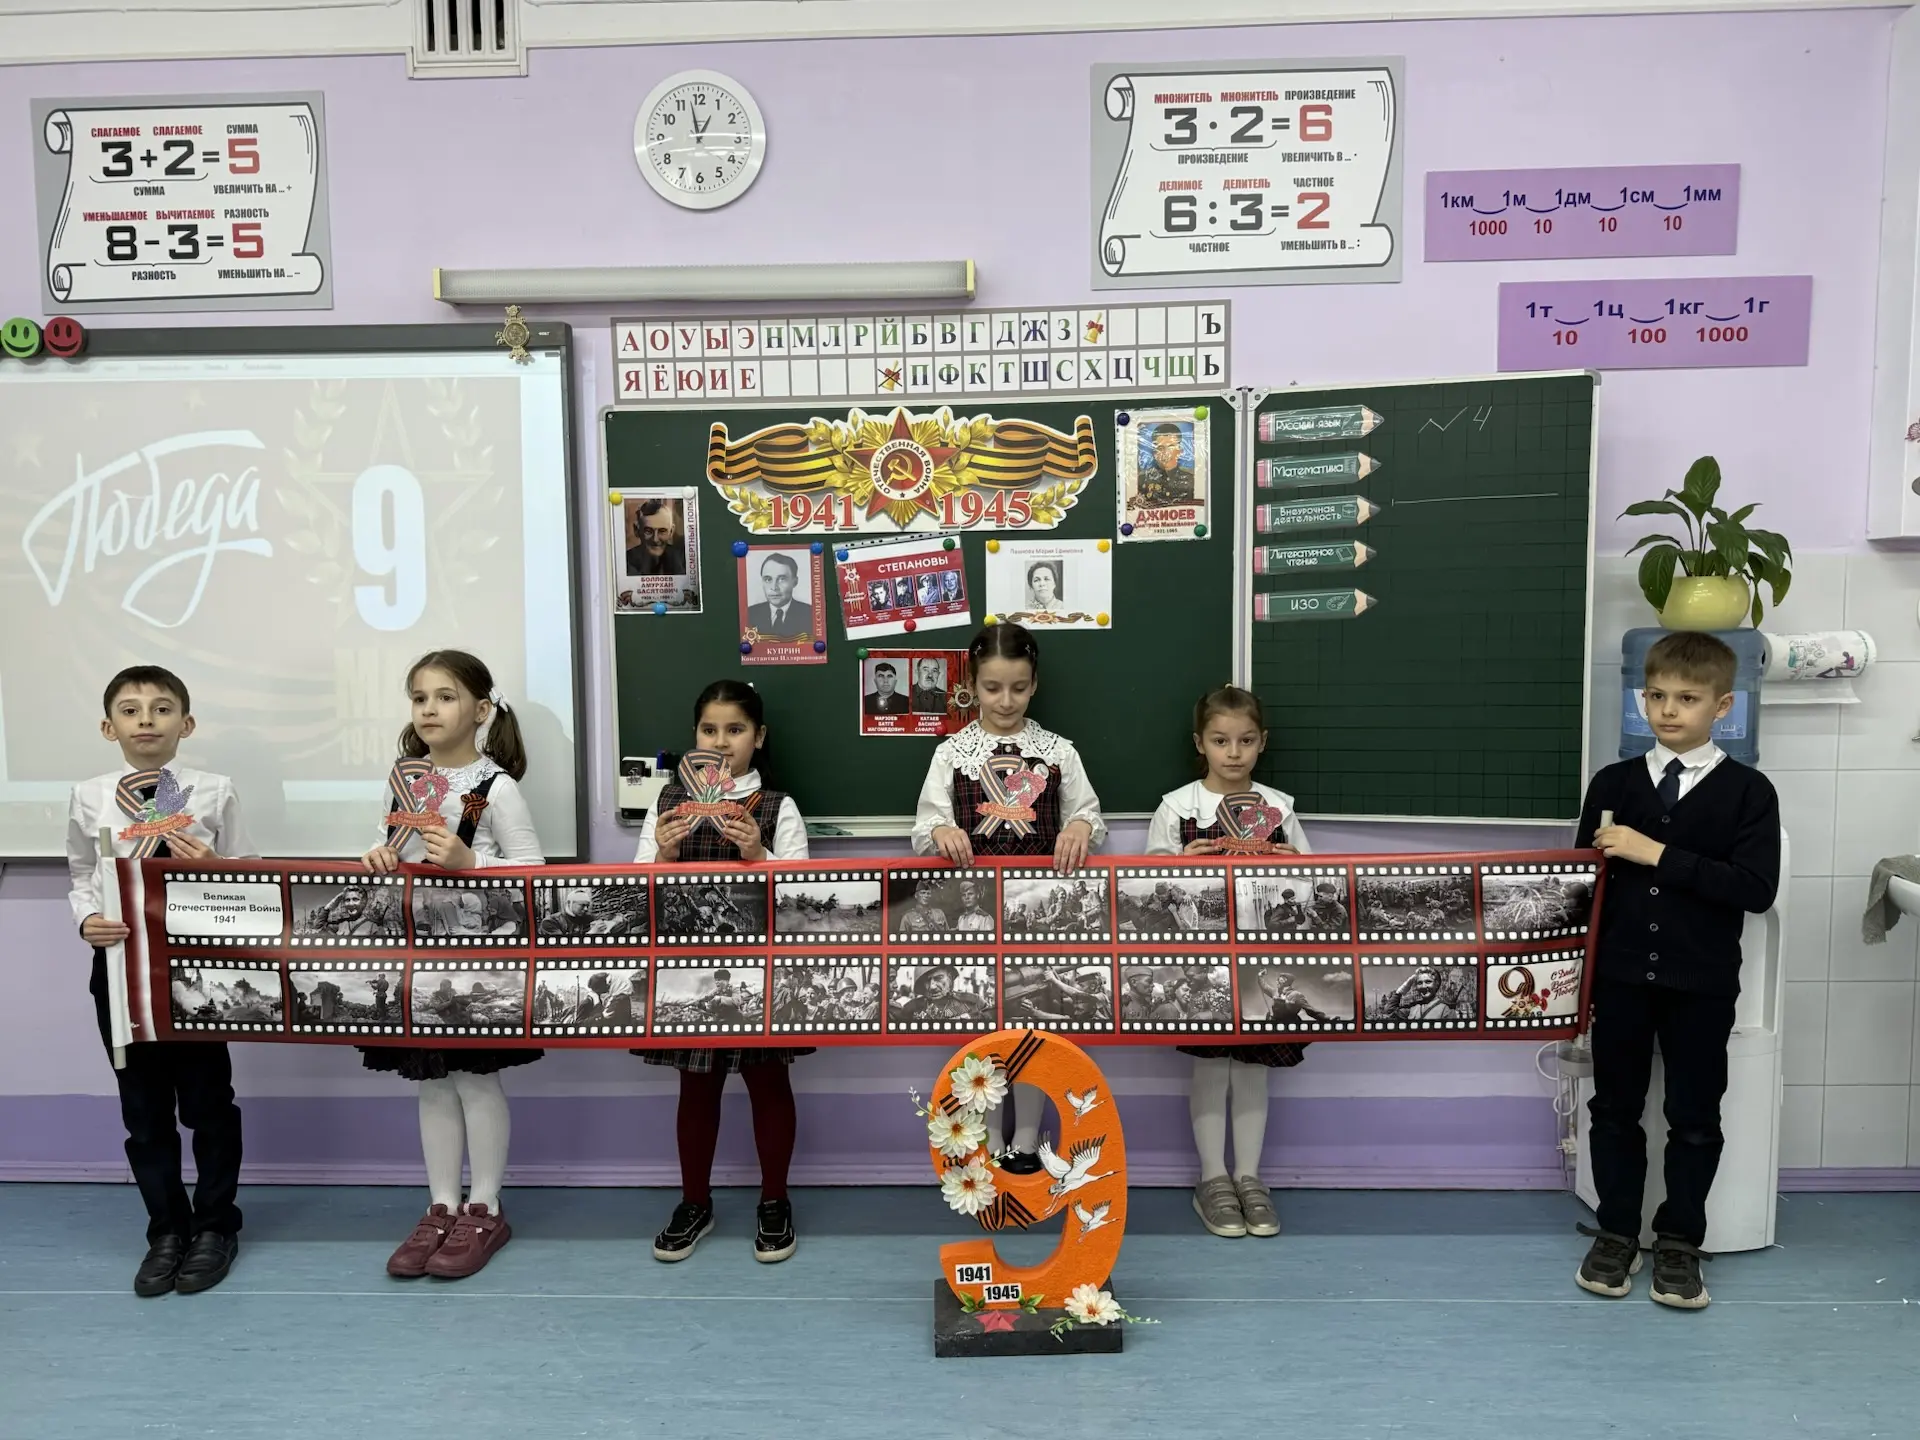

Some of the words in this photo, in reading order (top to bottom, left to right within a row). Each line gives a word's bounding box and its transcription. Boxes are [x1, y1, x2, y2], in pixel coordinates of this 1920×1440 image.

[693, 94, 706, 105] 12
[1154, 93, 1212, 104] МНОЖИТЕЛЬ
[1220, 91, 1278, 102] МНОЖИТЕЛЬ
[1285, 89, 1356, 100] ПРОИЗВЕДЕНИЕ
[676, 100, 685, 111] 11
[715, 99, 720, 110] 1
[663, 114, 675, 124] 10
[728, 113, 736, 124] 2
[91, 127, 140, 138] СЛАГАЕМОЕ
[153, 125, 203, 136] СЛАГАЕМОЕ
[226, 124, 258, 134] СУММА
[657, 134, 664, 144] 9
[664, 154, 671, 164] 8
[728, 155, 735, 164] 4
[1178, 153, 1248, 164] ПРОИЗВЕДЕНИЕ
[1282, 152, 1334, 162] УВЕЛИЧИТЬ
[1337, 152, 1342, 162] В
[678, 168, 686, 178] 7
[696, 172, 704, 183] 6
[716, 167, 722, 178] 5
[214, 184, 263, 194] УВЕЛИЧИТЬ
[265, 184, 276, 193] НА
[1159, 180, 1202, 192] ДЕЛИМОЕ
[1223, 178, 1270, 190] ДЕЛИТЕЛЬ
[1294, 178, 1334, 188] ЧАСТНОЕ
[134, 186, 165, 196] СУММА
[83, 210, 148, 222] УМЕНЬШАЕМОЕ
[156, 209, 214, 220] ВЫЧИТАЕМОЕ
[224, 208, 269, 218] РАЗНОСТЬ
[1469, 220, 1507, 236] 1000
[1534, 219, 1552, 234] 10
[1598, 217, 1617, 232] 10
[1663, 216, 1682, 231] 10
[1189, 242, 1230, 252] ЧАСТНОЕ
[1281, 240, 1338, 250] УМЕНЬШИТЬ
[1340, 240, 1346, 249] В
[132, 270, 176, 281] РАЗНОСТЬ
[218, 268, 272, 279] УМЕНЬШИТЬ
[274, 268, 285, 278] НА
[622, 330, 640, 350] А
[650, 330, 669, 350] О
[680, 329, 697, 350] У
[706, 328, 728, 349] Ы
[738, 328, 754, 349] Э
[766, 328, 784, 348] Н
[792, 326, 814, 348] М
[823, 325, 841, 346] Л
[854, 324, 868, 346] Р
[881, 318, 900, 346] Й
[911, 324, 928, 344] Б
[940, 322, 956, 344] В
[969, 321, 984, 344] Г
[996, 320, 1015, 348] Д
[1022, 319, 1046, 342] Ж
[1058, 318, 1070, 340] З
[1202, 313, 1222, 335] Ъ
[1553, 329, 1578, 346] 10
[1628, 328, 1666, 345] 100
[1696, 326, 1748, 343] 1000
[624, 370, 642, 392] Я
[654, 365, 668, 391] Ё
[678, 370, 703, 391] Ю
[710, 369, 728, 390] И
[740, 368, 756, 390] Е
[911, 364, 930, 386] П
[938, 364, 960, 385] Ф
[969, 362, 986, 384] К
[998, 362, 1015, 384] Т
[1023, 360, 1048, 382] Ш
[1056, 360, 1074, 382] С
[1084, 359, 1102, 380] Х
[1113, 358, 1132, 384] Ц
[1142, 356, 1160, 378] Ч
[1168, 356, 1195, 383] Щ
[1204, 354, 1220, 376] Ь
[873, 441, 926, 494] ОТЕЧЕСТВЕННАЯ
[1273, 465, 1343, 477] Математика
[768, 494, 858, 531] 1941
[940, 491, 1033, 528] 1945
[1280, 506, 1335, 516] Внеурочная
[1136, 509, 1195, 523] ДЖИОЕВ
[1273, 513, 1341, 525] деятельность
[22, 429, 273, 628] Победа
[352, 464, 427, 631] 9
[687, 525, 696, 586] БЕССМЕРТНЫЙ
[1270, 549, 1334, 559] Литературное
[878, 556, 948, 573] СТЕПАНОВЫ
[1286, 558, 1318, 566] чтение
[1291, 598, 1319, 611] ИЗО
[204, 893, 246, 901] Великая
[168, 904, 246, 912] Отечественная
[249, 904, 281, 912] Война
[929, 1029, 1128, 1310] 9
[957, 1266, 991, 1282] 1941
[985, 1285, 1020, 1300] 1945
